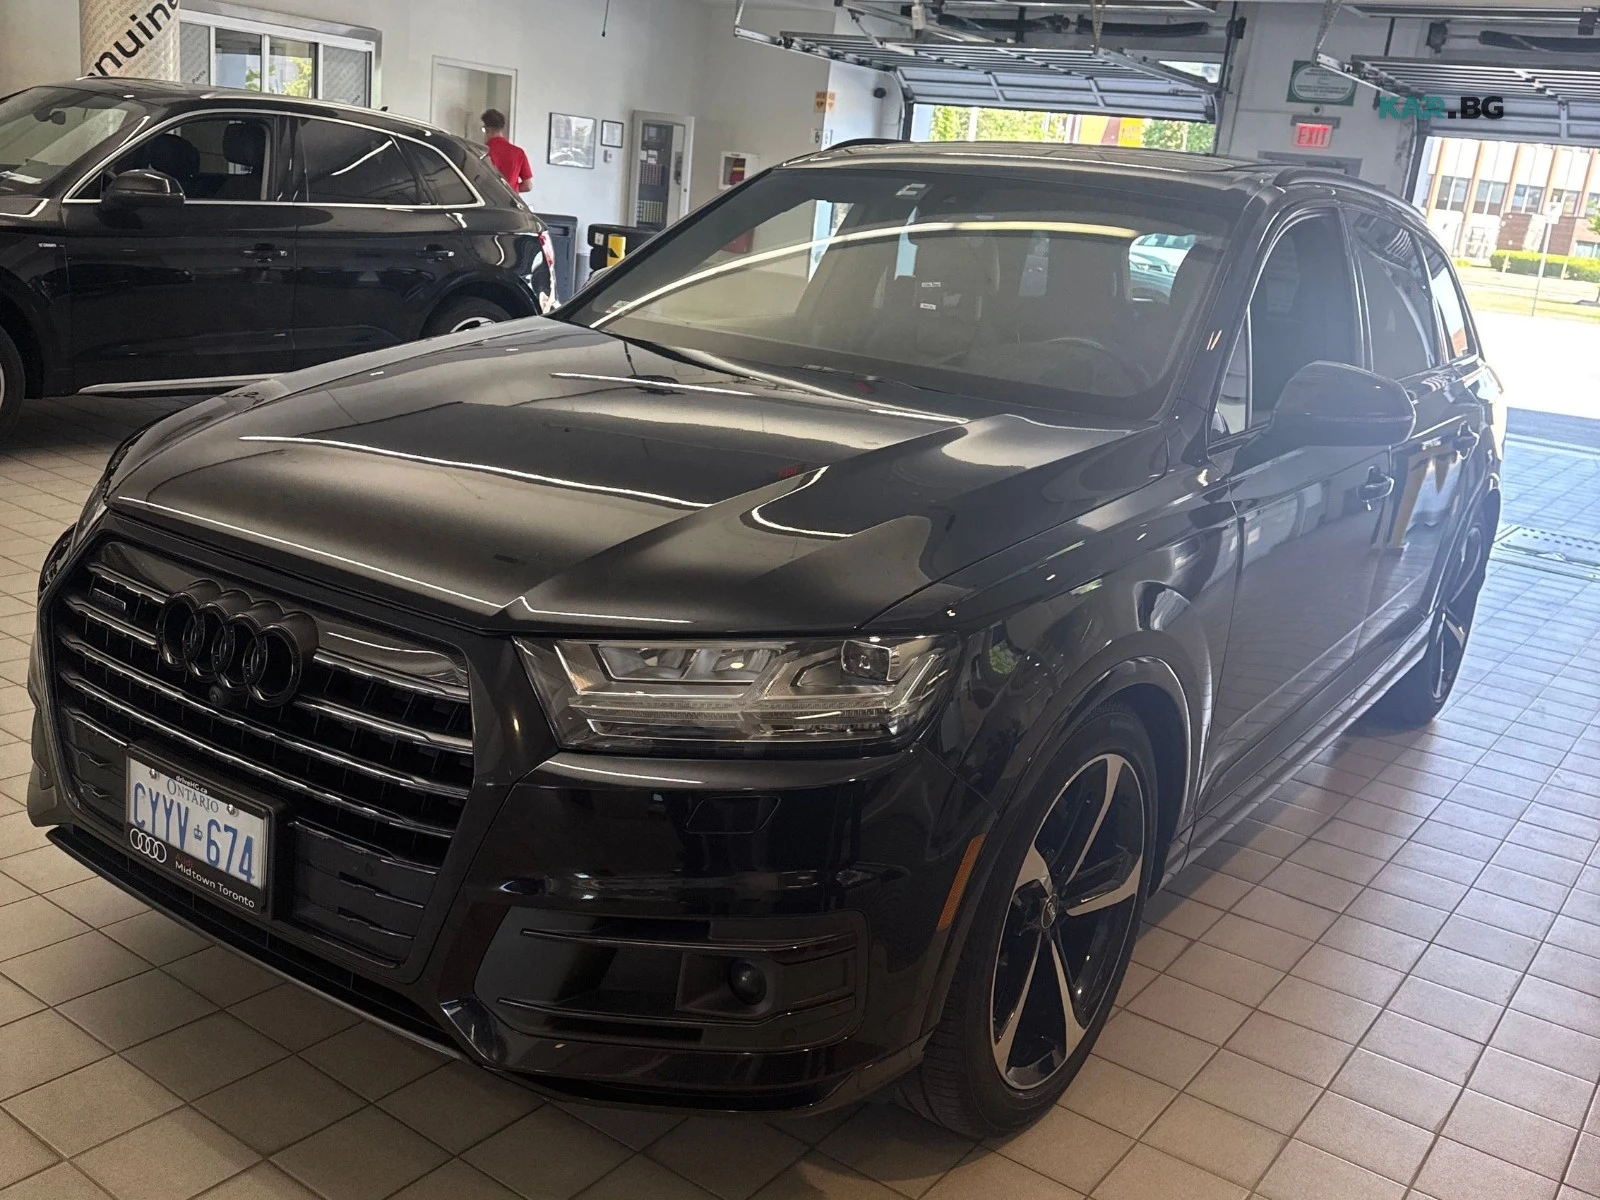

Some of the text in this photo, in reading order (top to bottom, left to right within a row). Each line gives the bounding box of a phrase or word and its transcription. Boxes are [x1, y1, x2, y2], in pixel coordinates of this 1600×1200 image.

[1297, 127, 1329, 145] EXIT
[167, 778, 219, 813] ONTARIO
[175, 775, 208, 795] driveHG.ca
[134, 782, 254, 881] CYYV 674
[175, 861, 255, 908] Midtown Toronto
